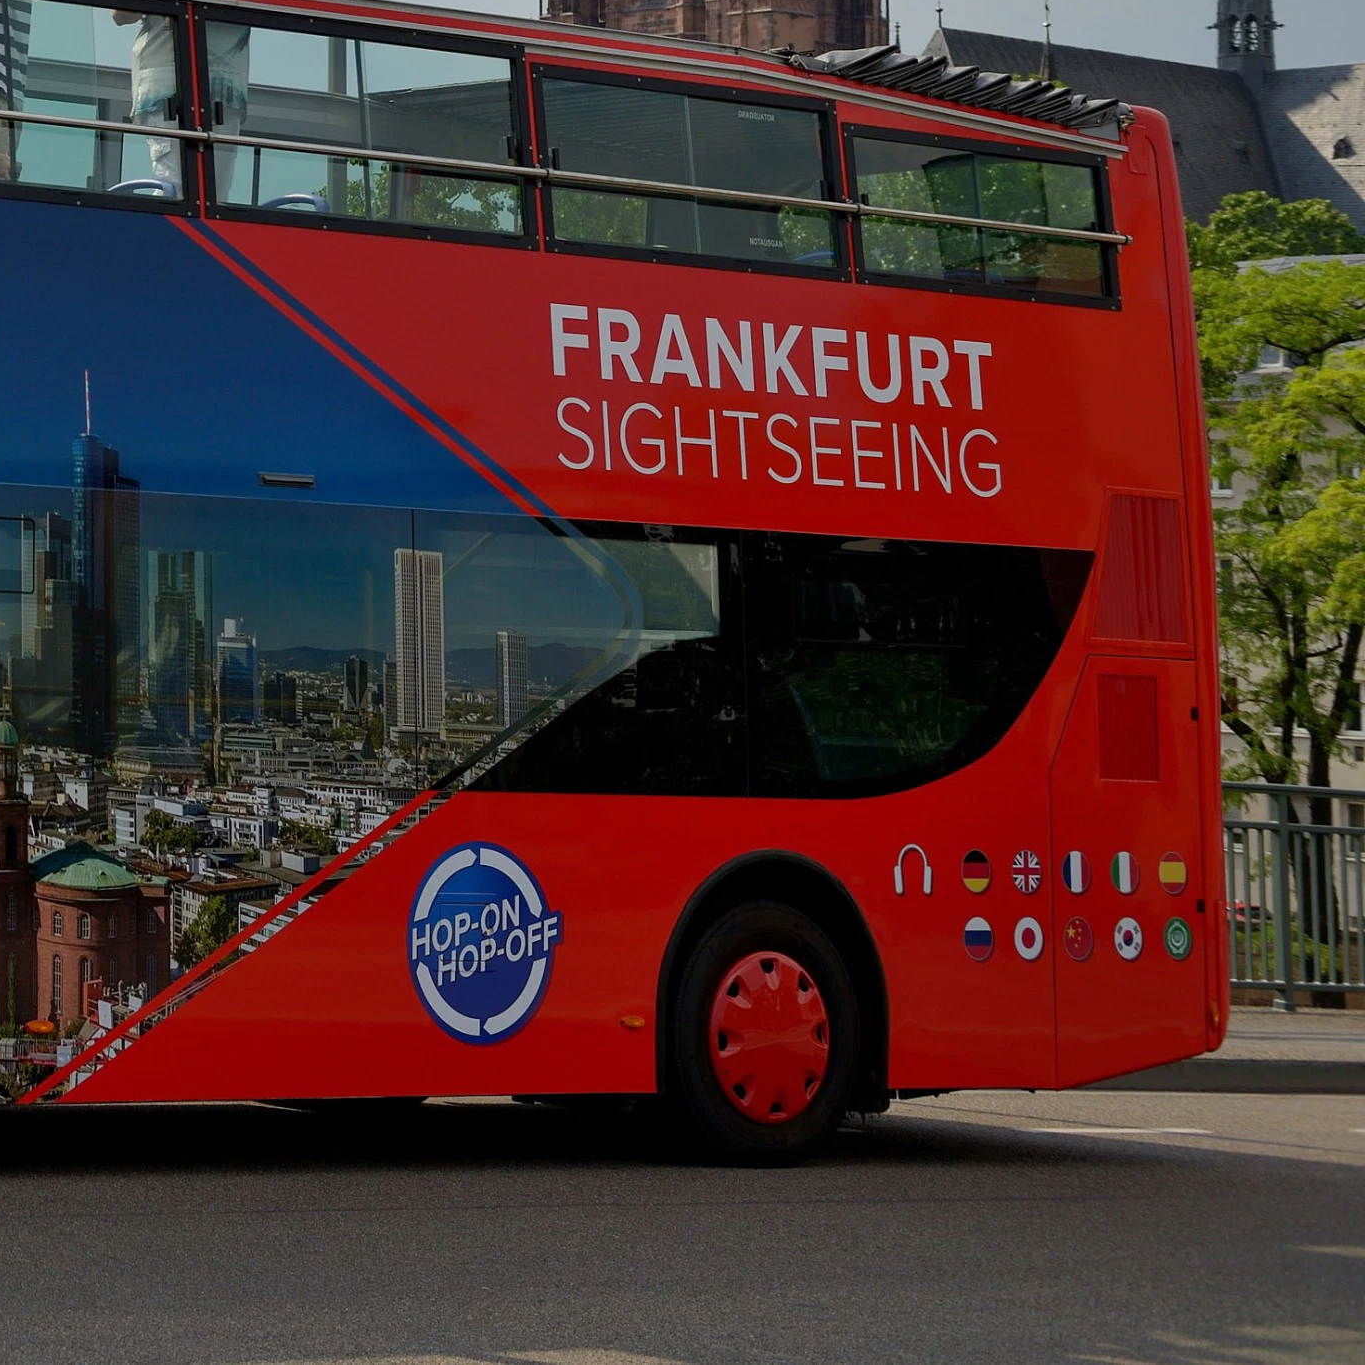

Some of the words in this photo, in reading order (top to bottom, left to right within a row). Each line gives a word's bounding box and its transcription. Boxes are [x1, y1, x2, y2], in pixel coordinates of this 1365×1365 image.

[749, 237, 787, 248] NOTAUSGAN
[550, 302, 993, 411] FRANKFURT
[557, 396, 1003, 498] SIGHTSEEING
[412, 895, 519, 960] HOP-ON
[438, 917, 558, 986] HOP-OFF
